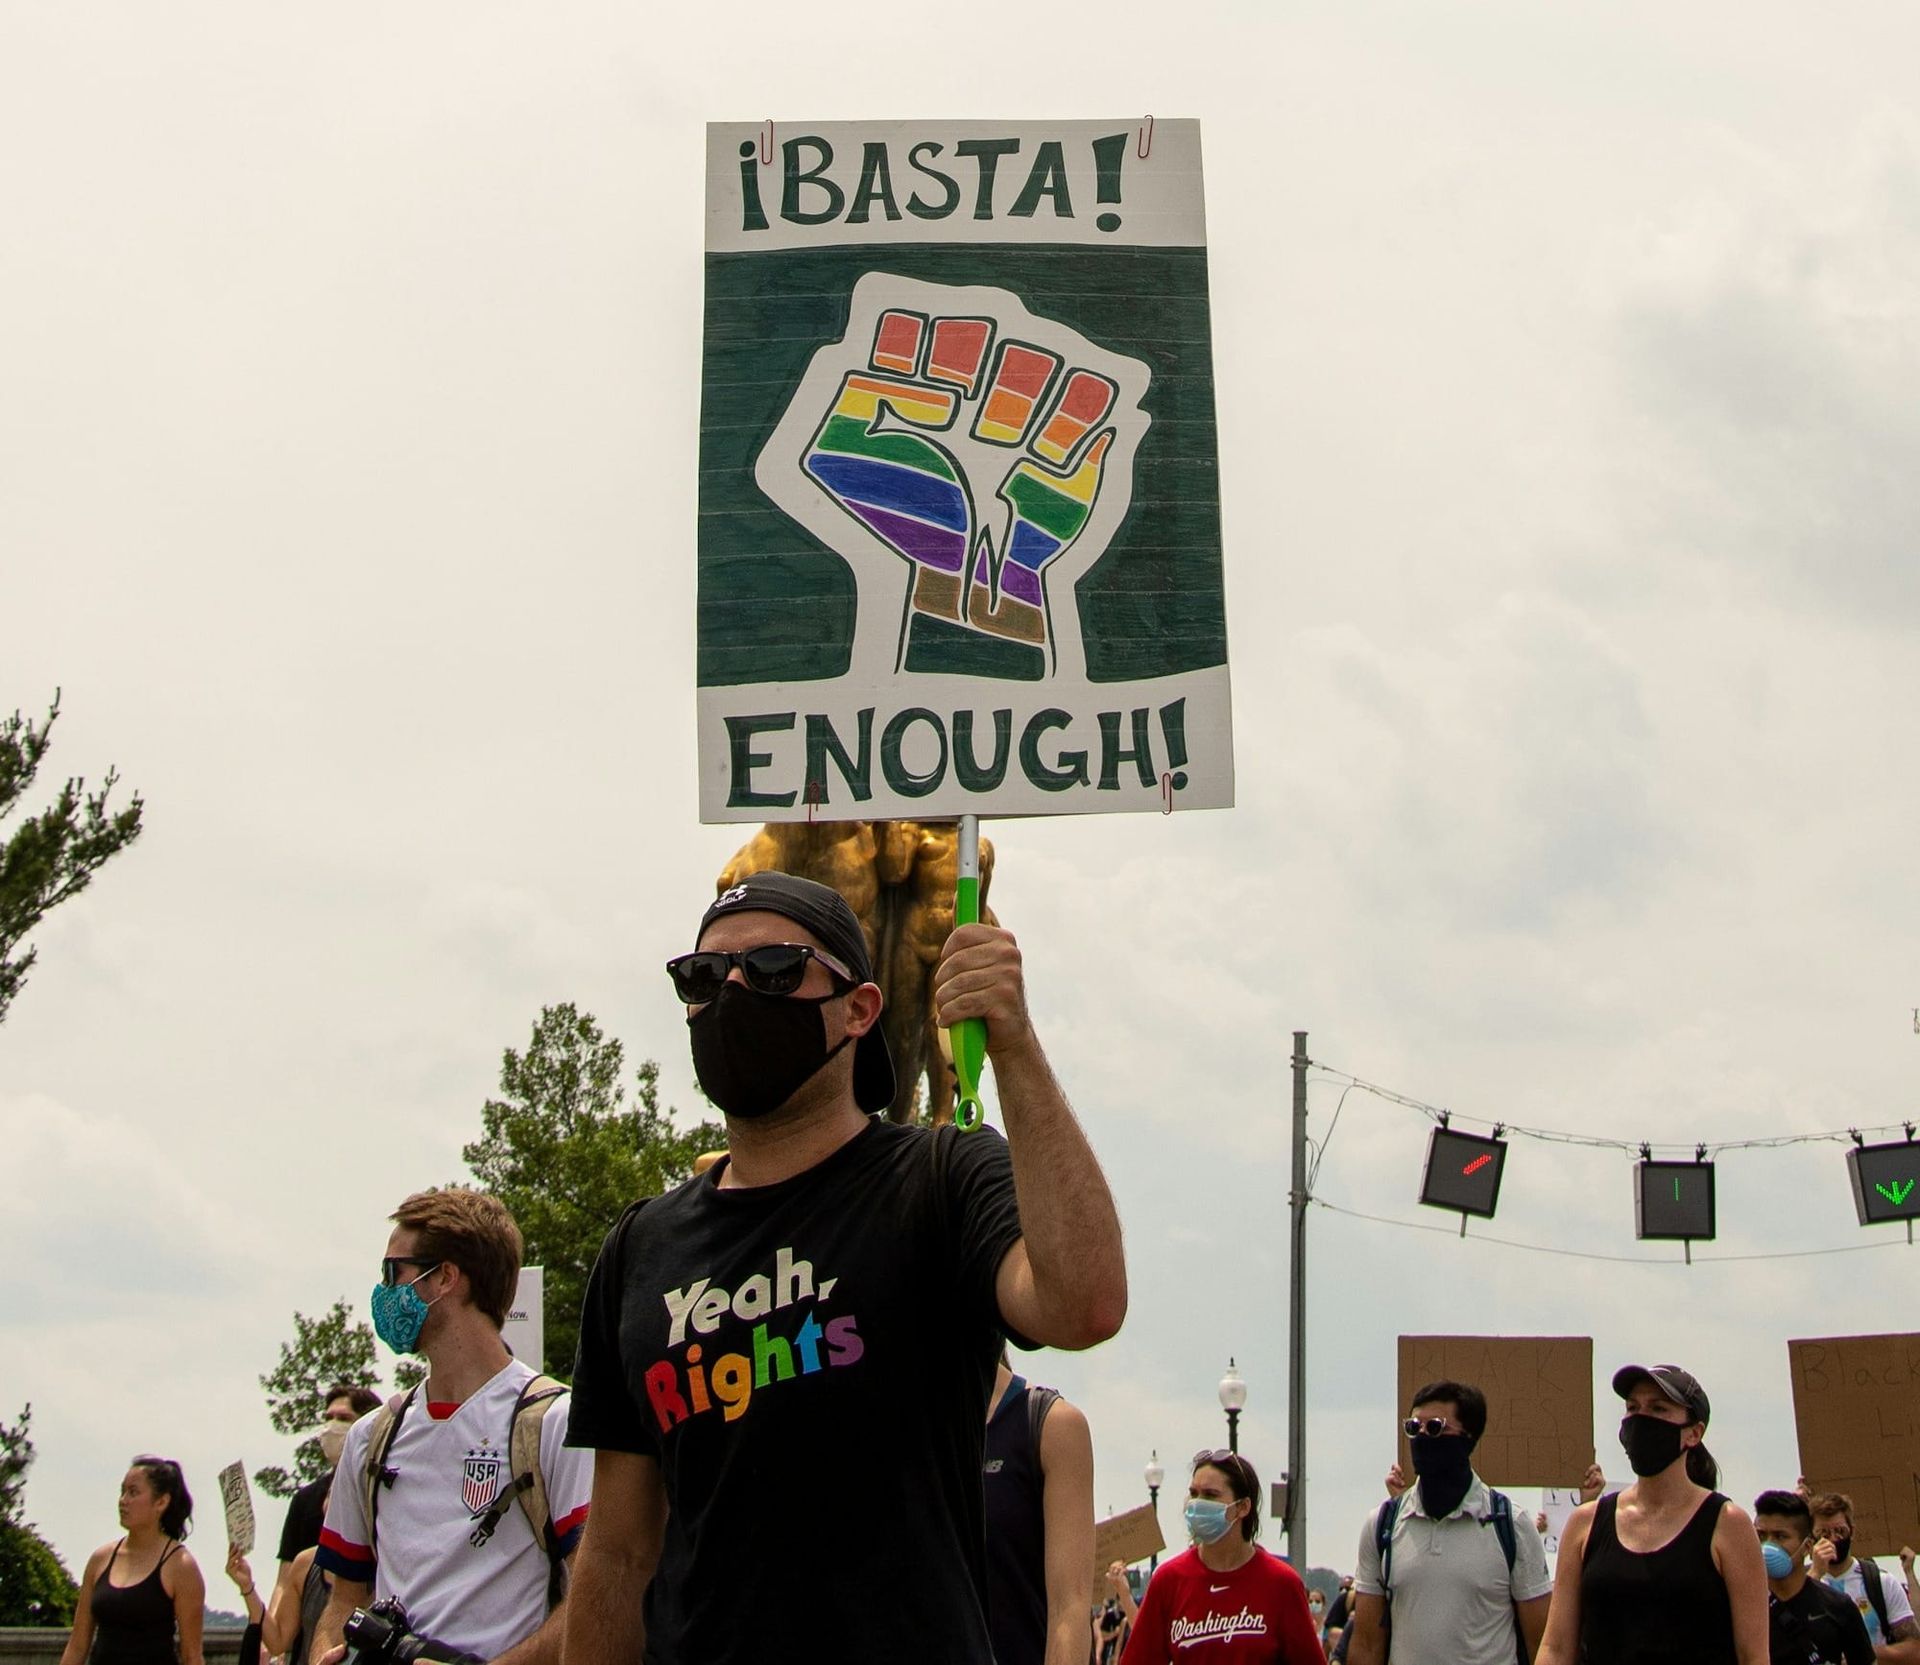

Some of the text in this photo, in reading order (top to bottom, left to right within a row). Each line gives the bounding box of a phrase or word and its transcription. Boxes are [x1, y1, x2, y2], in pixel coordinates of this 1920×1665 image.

[739, 132, 1129, 233] ¡BASTA!
[723, 697, 1188, 808] ENOUGH!
[663, 1247, 838, 1348] Yeah,
[644, 1310, 864, 1434] Rights
[467, 1462, 496, 1482] USA
[1170, 1605, 1267, 1648] Washington
